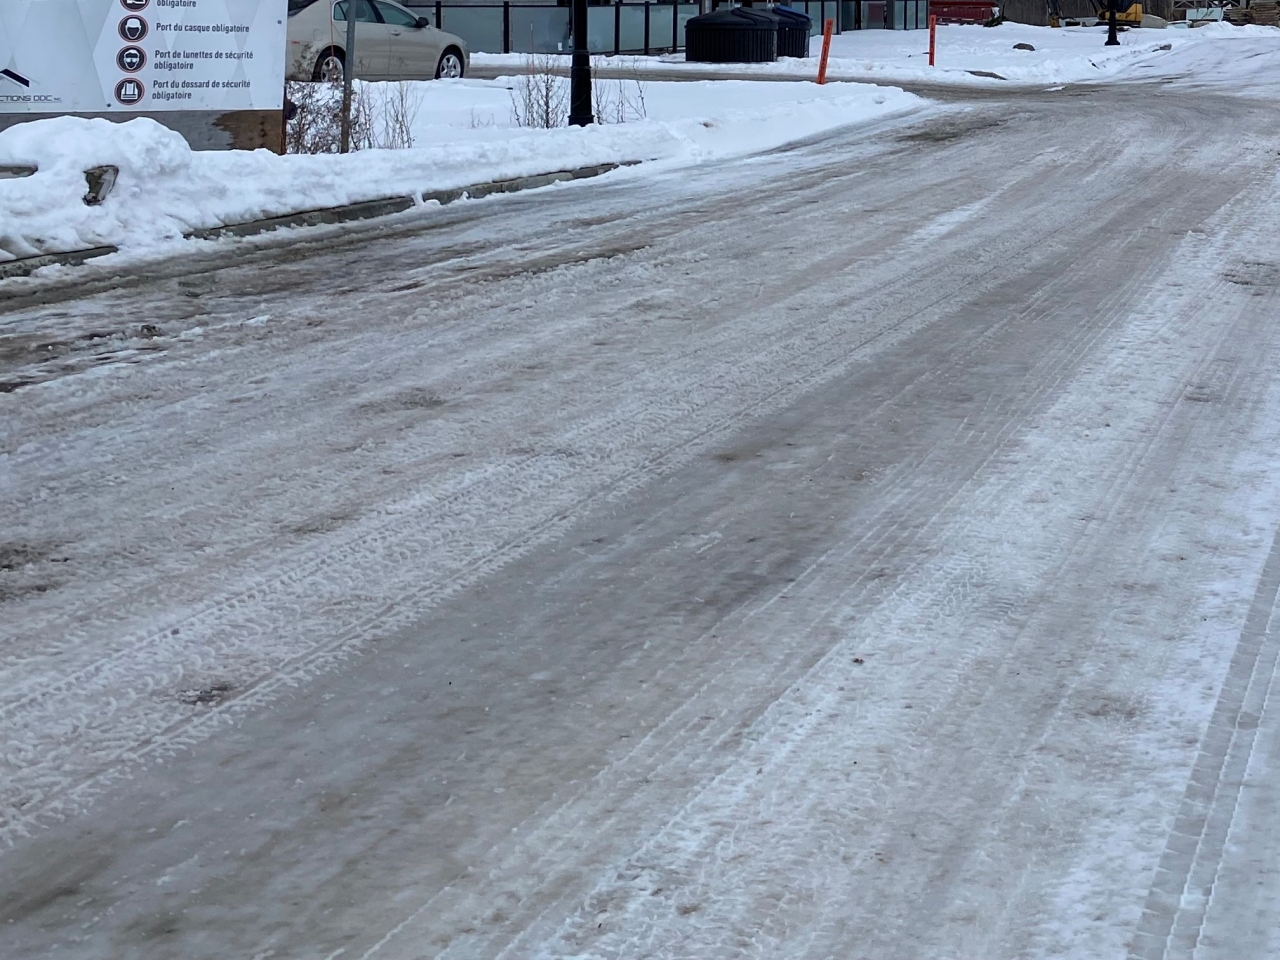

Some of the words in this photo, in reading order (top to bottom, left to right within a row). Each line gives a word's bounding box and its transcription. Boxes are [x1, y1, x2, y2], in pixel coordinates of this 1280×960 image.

[156, 23, 172, 32] Port
[174, 23, 183, 32] du
[184, 25, 210, 35] casque
[212, 24, 250, 34] obligatoire
[154, 50, 171, 59] Port
[173, 50, 181, 59] de
[182, 50, 213, 59] lunettes
[215, 50, 223, 59] de
[225, 51, 253, 60] sécurité
[154, 61, 194, 71] obligatoire
[153, 80, 169, 89] Port
[171, 80, 180, 89] du
[181, 80, 210, 88] dossard
[212, 80, 220, 88] de
[221, 79, 251, 88] sécurité
[152, 91, 192, 101] obligatoire
